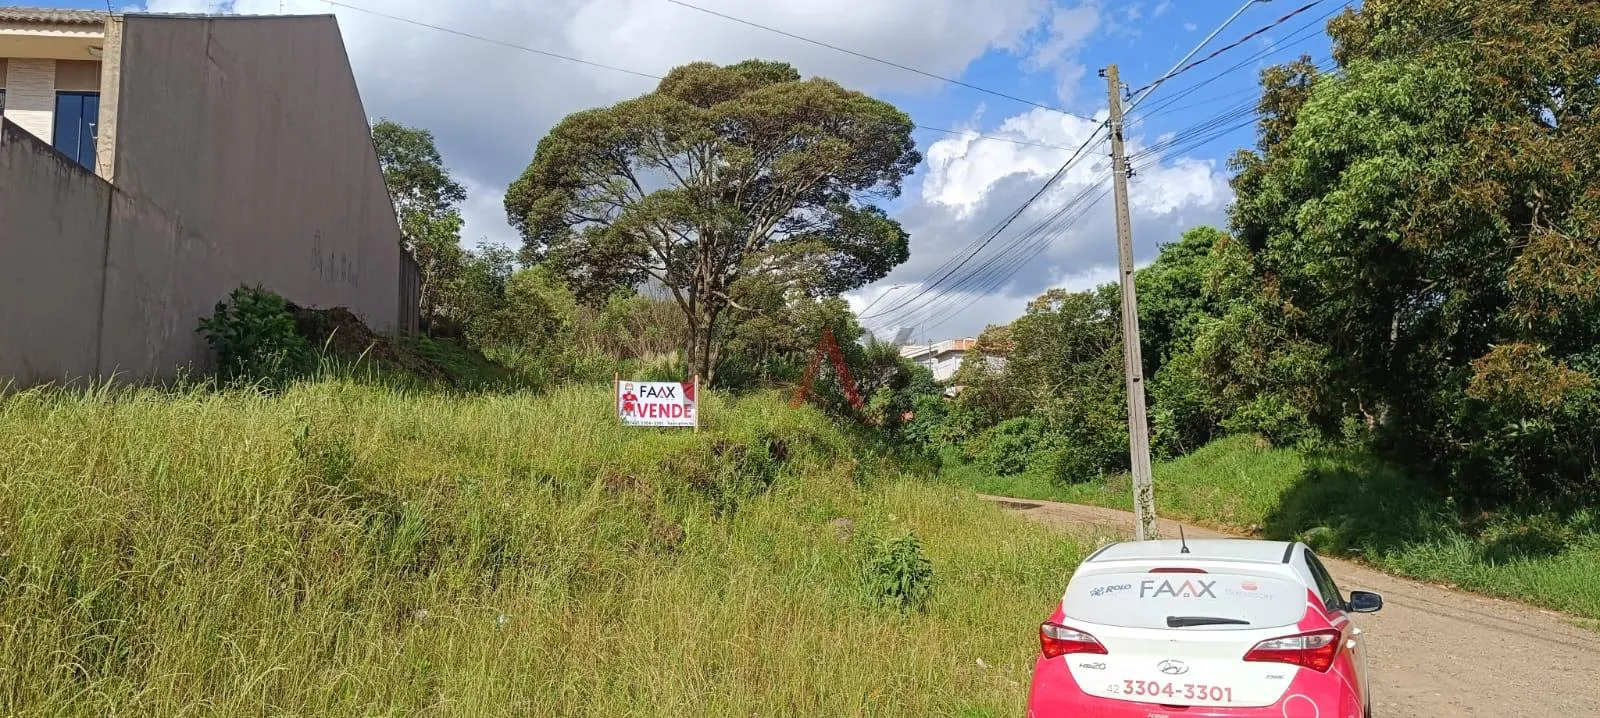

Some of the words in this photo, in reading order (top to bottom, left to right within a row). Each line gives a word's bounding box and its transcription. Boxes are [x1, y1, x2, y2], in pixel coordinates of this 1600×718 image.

[640, 385, 676, 398] FAAX
[637, 403, 692, 418] VENDE
[1139, 579, 1217, 599] FAAX
[1106, 684, 1120, 694] 42
[1123, 679, 1232, 702] 3304-3301
